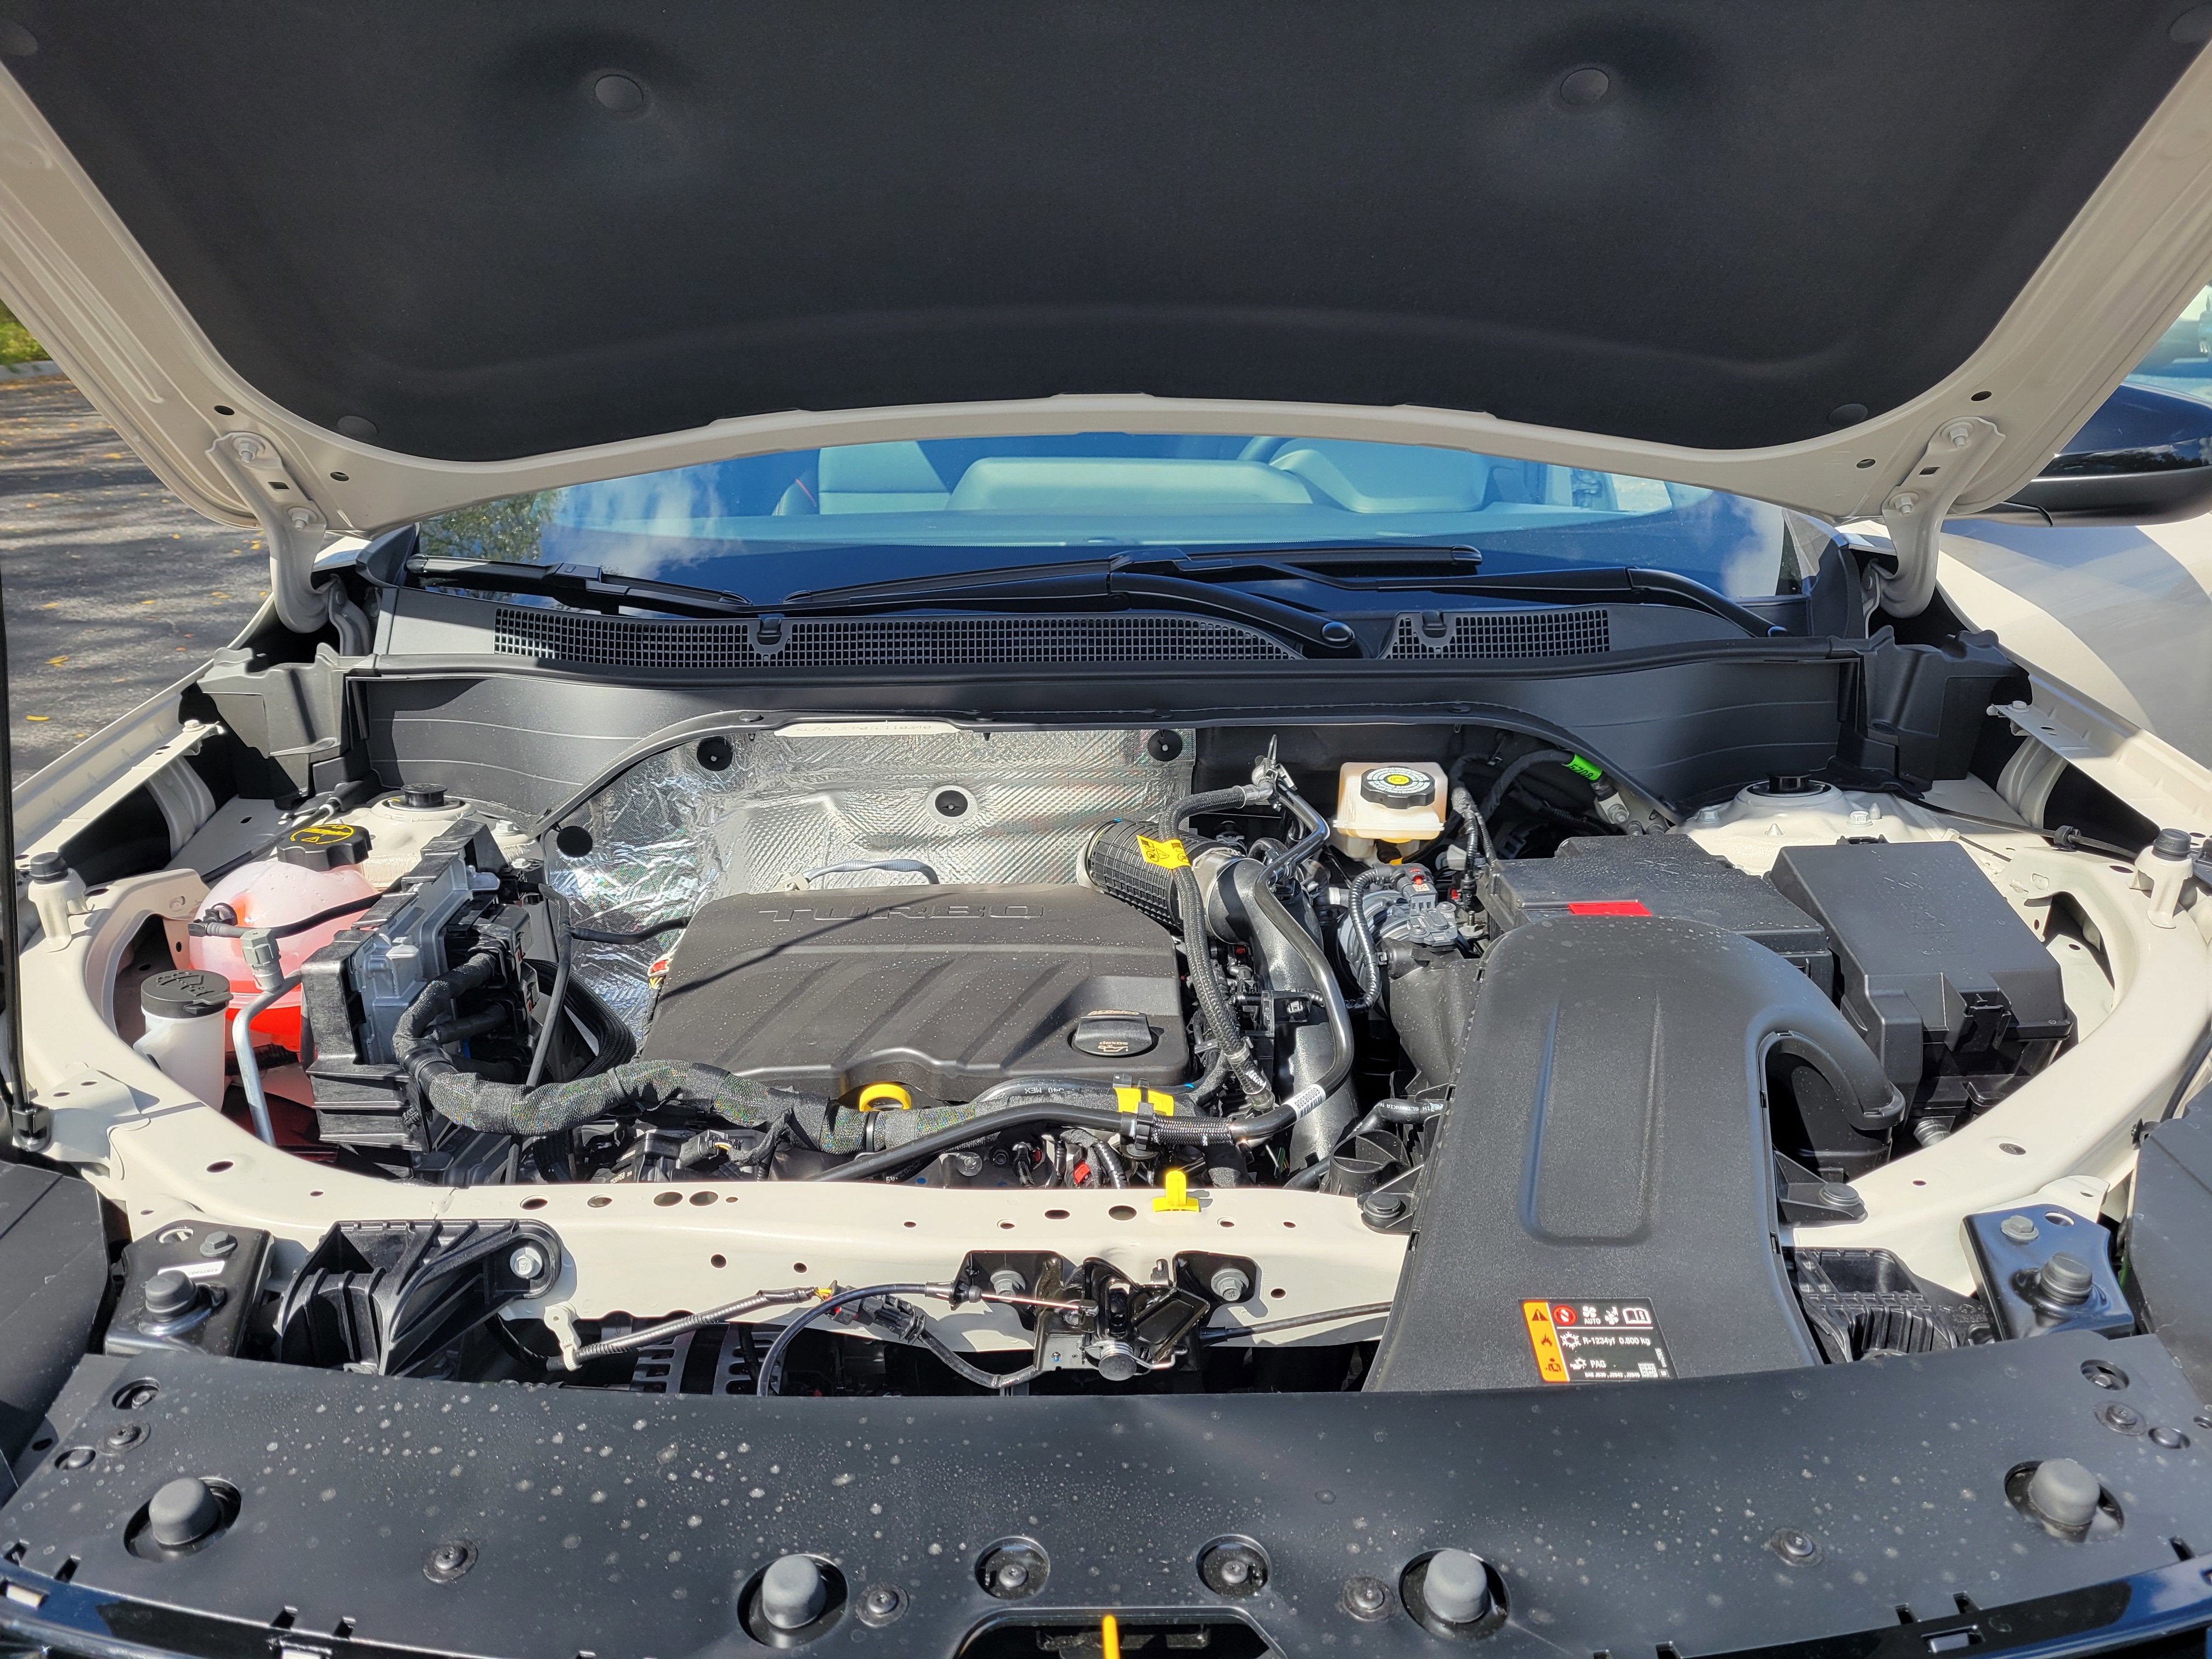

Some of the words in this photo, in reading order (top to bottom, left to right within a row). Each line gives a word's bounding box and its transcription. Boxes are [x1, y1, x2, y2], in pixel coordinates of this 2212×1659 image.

[759, 905, 1044, 922] TURBO
[1582, 1336, 1615, 1346] R-1234yf
[1639, 1337, 1651, 1346] kg
[1590, 1360, 1607, 1369] PAG
